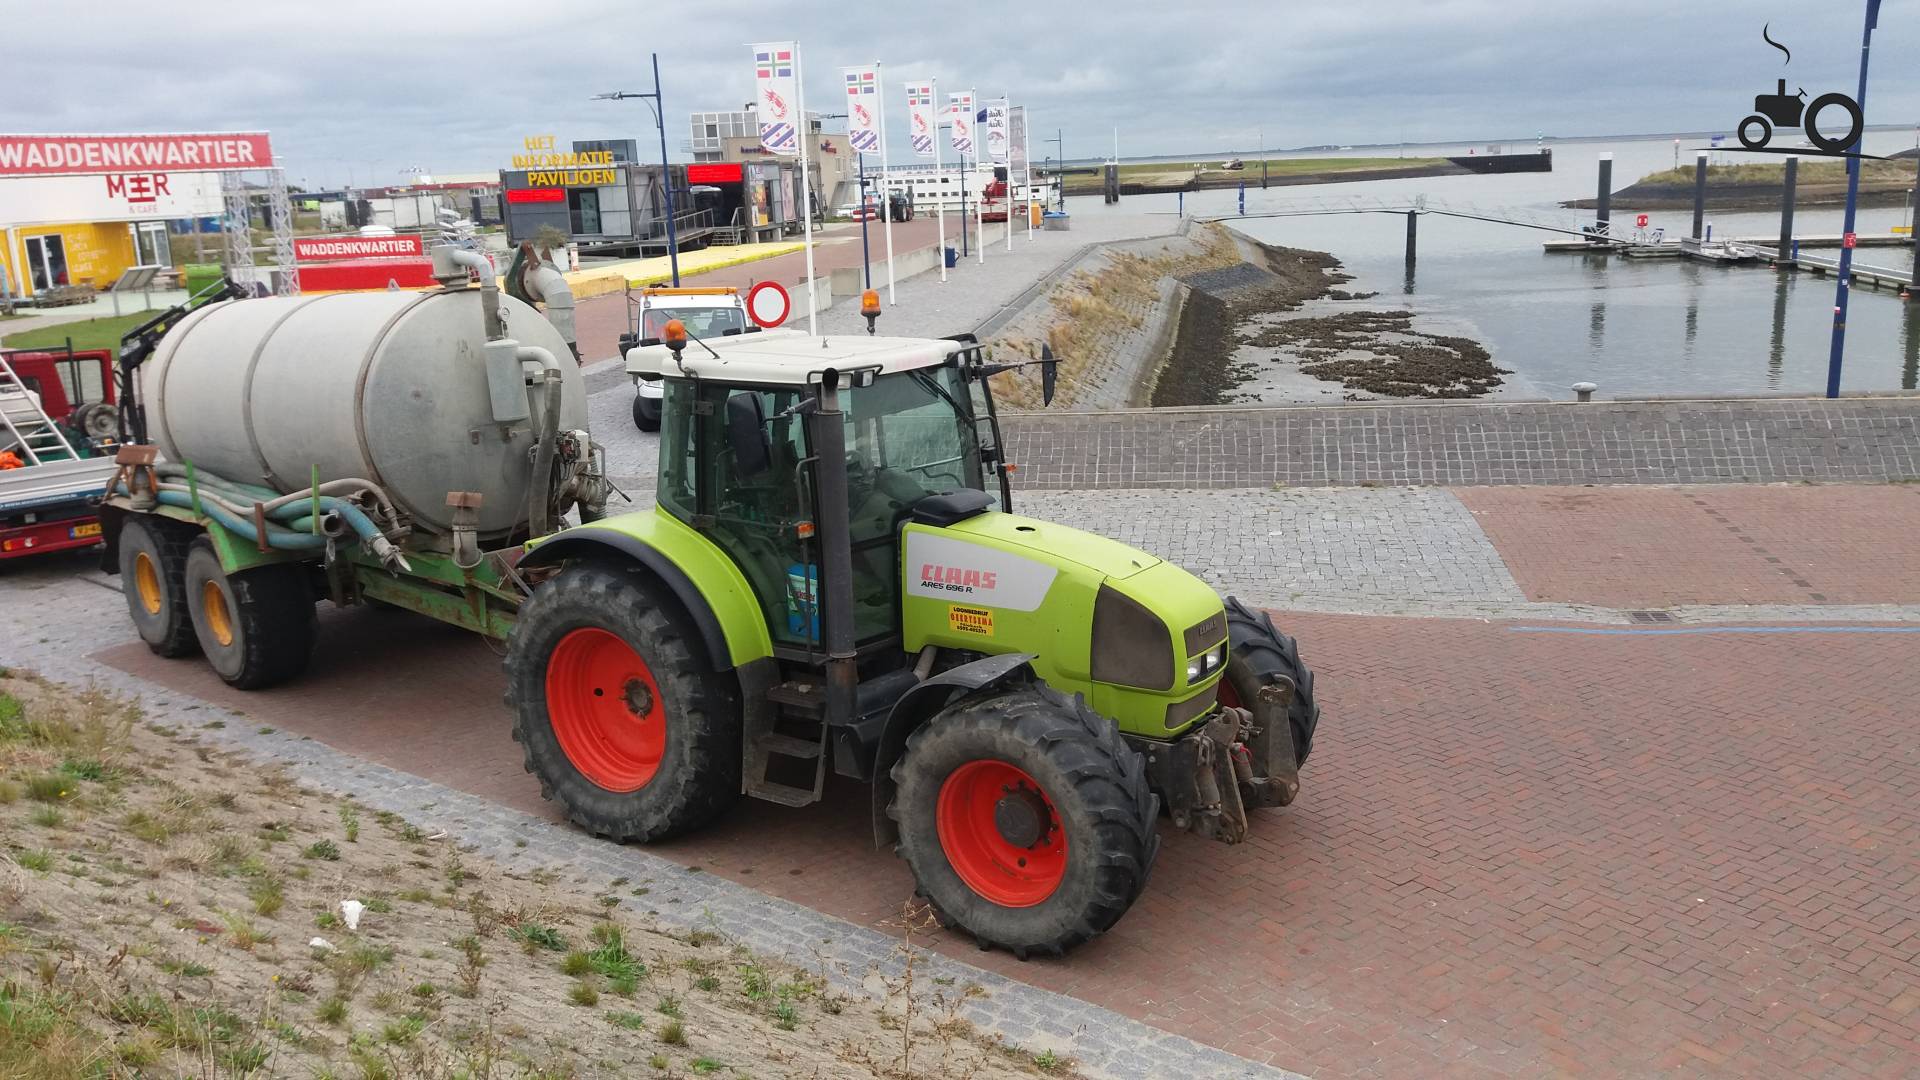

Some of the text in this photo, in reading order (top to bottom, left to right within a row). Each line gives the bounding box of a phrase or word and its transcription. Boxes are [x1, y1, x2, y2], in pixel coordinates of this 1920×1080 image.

[524, 136, 555, 150] HET
[0, 140, 255, 168] WADDENKWARTIER
[512, 151, 613, 168] INFORMATIE
[527, 169, 616, 186] PAVILJOEN
[299, 240, 415, 256] WADDENKWARTIER
[921, 564, 996, 589] CLAAS
[921, 580, 944, 590] ARES
[945, 584, 964, 592] 696
